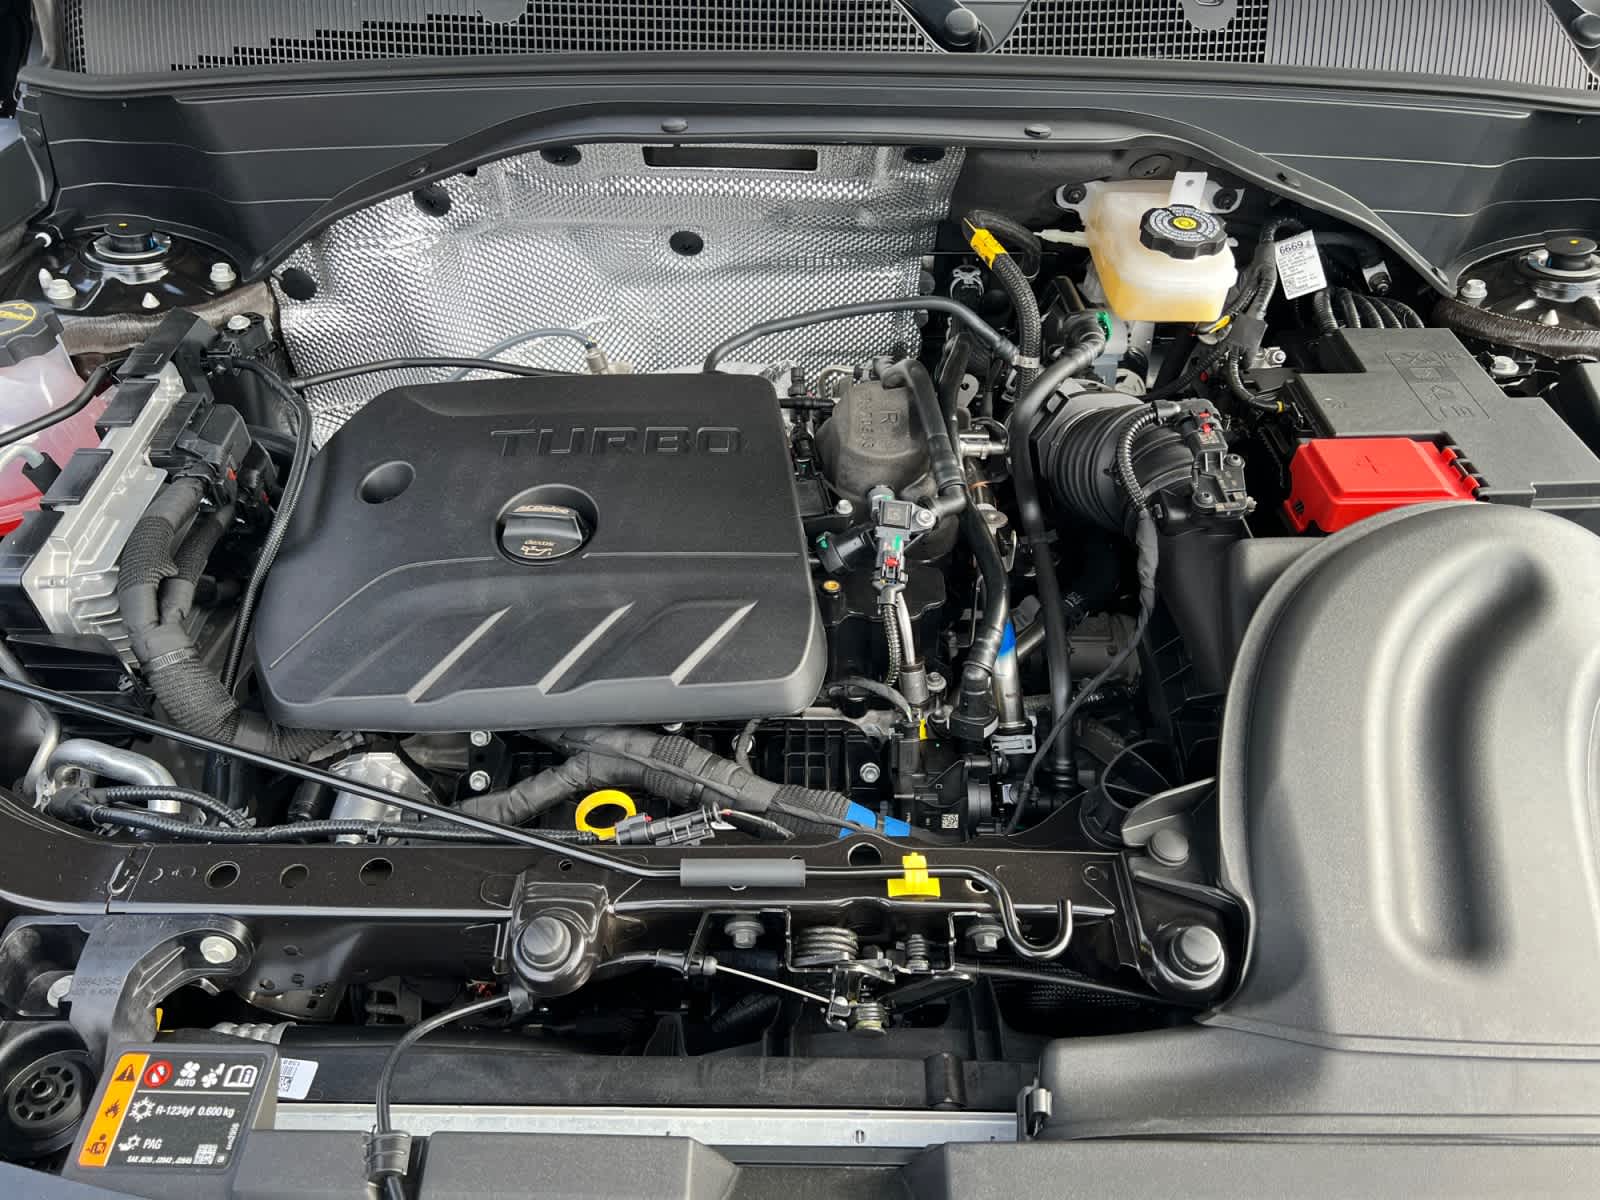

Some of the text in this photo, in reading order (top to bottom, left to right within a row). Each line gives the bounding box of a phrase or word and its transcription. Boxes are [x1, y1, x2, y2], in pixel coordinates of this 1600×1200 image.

[490, 426, 741, 456] TURBO
[174, 1078, 197, 1087] AUTO
[197, 1106, 223, 1117] 0.600
[223, 1106, 235, 1118] kg
[142, 1138, 163, 1150] PAG
